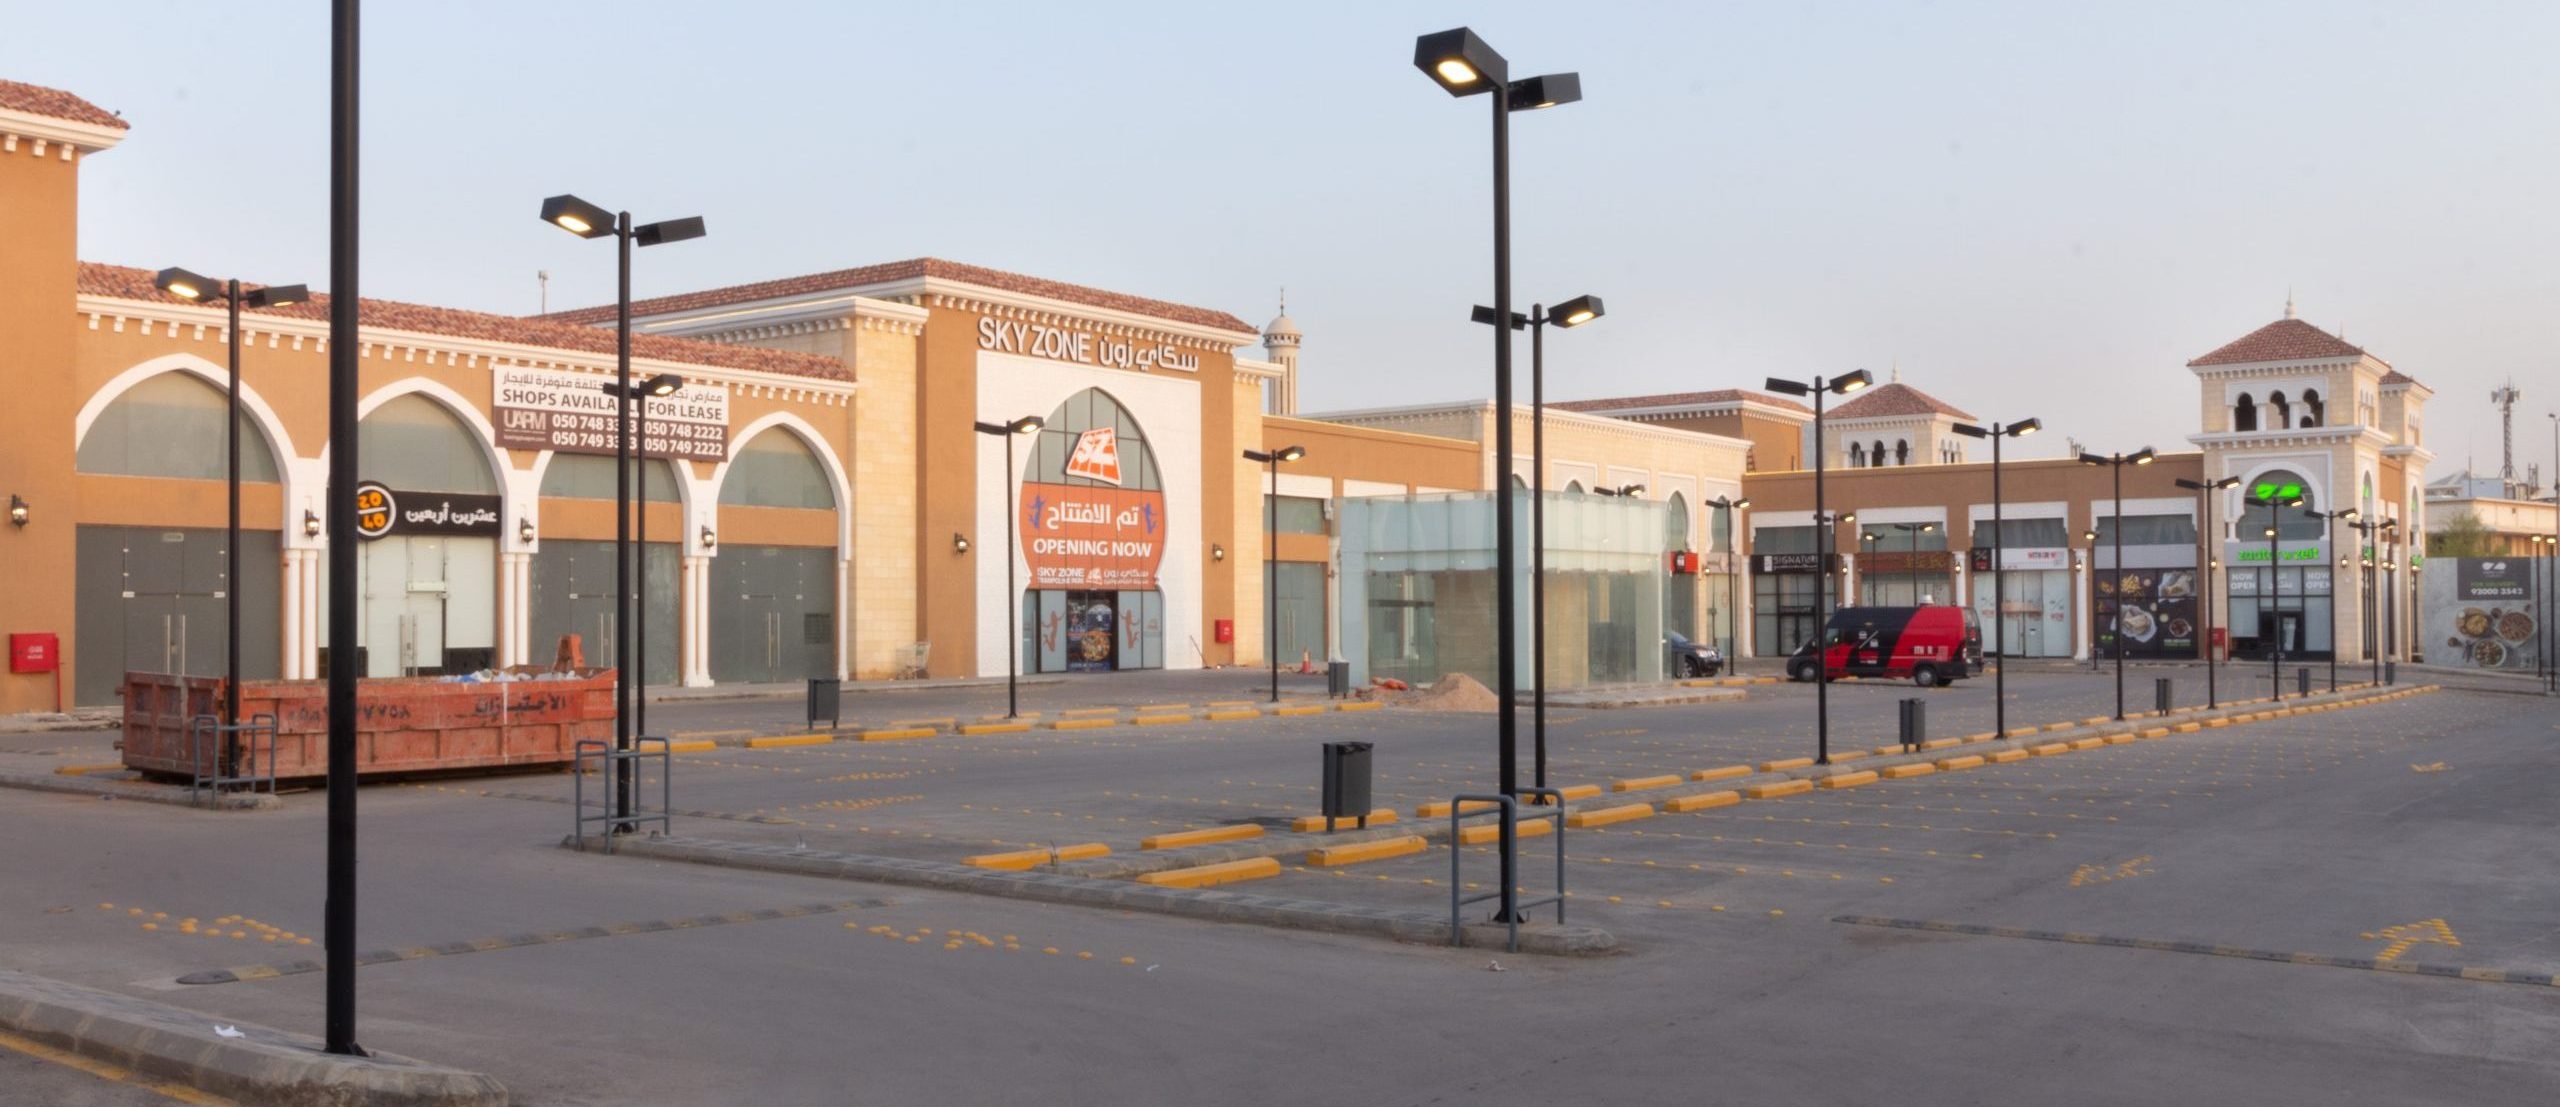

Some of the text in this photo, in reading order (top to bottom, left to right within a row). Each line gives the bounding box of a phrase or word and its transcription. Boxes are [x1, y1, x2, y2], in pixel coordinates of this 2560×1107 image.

[979, 316, 1092, 363] SKY ZONE
[1100, 335, 1199, 373] سكاي زون
[574, 379, 604, 392] ختلفة
[689, 388, 723, 405] معارض
[502, 388, 557, 407] SHOPS
[647, 401, 677, 417] FOR
[679, 405, 723, 421] LEASE
[552, 414, 723, 441] 050 748 333 050 748 2222
[552, 431, 577, 447] 050
[580, 434, 604, 448] 749
[606, 434, 638, 450] 333
[644, 437, 668, 452] 050
[669, 439, 692, 454] 749
[693, 441, 723, 456] 2222
[1075, 433, 1115, 465] SZ
[405, 501, 498, 525] عشرين أربعين
[1046, 501, 1140, 532] تم الافتتاح
[1033, 538, 1153, 558] OPENING NOW
[1037, 566, 1085, 578] SKY ZONE
[2230, 582, 2256, 590] OPEN
